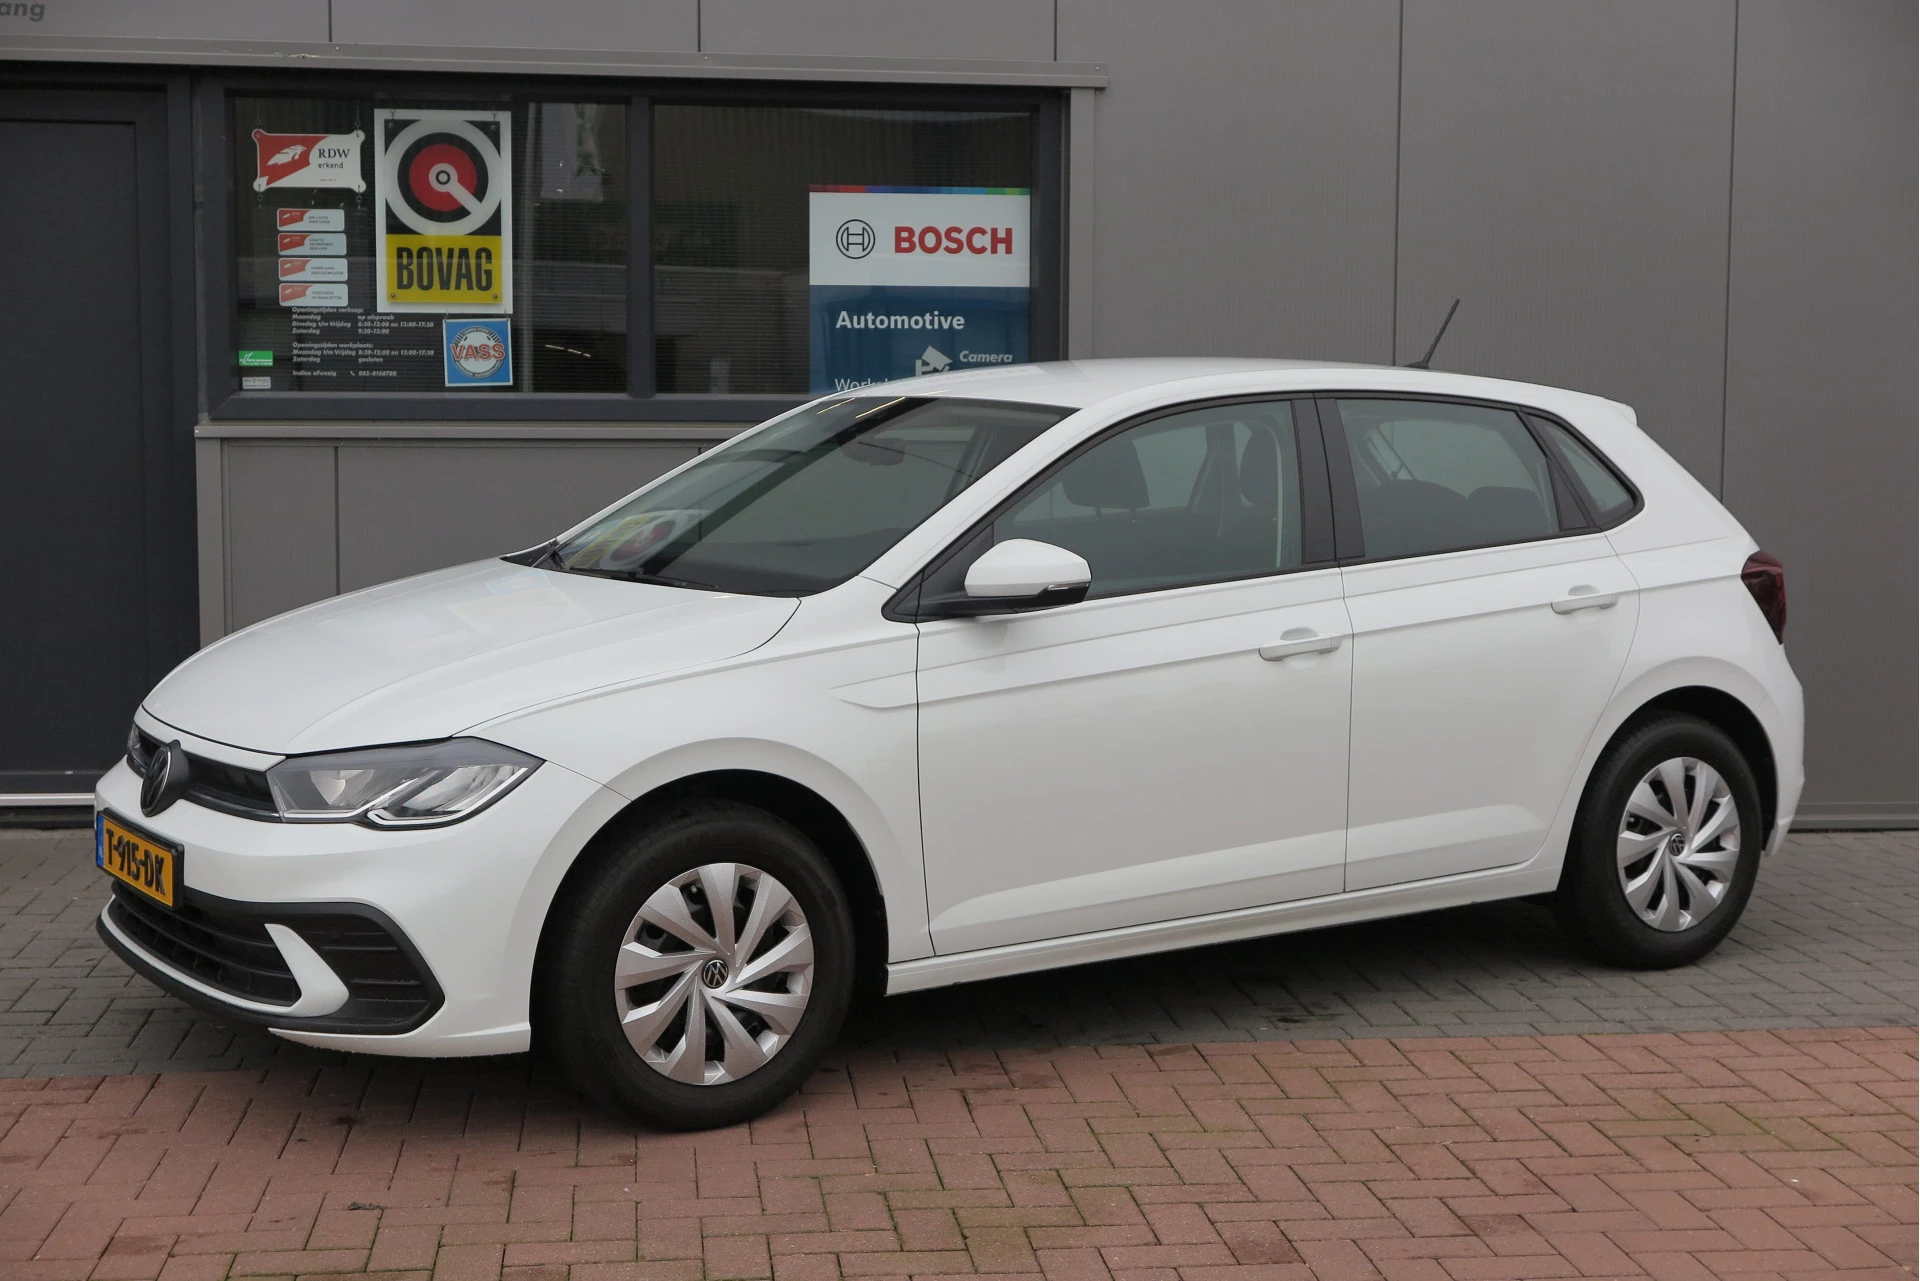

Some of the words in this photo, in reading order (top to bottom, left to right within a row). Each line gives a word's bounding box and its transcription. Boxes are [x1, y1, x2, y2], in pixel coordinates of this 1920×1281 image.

[318, 148, 350, 159] RDW
[894, 226, 1013, 255] BOSCH
[396, 246, 493, 292] BOVAG
[835, 310, 965, 330] Automotive
[450, 343, 505, 361] VASS
[959, 350, 1013, 363] Camera
[106, 827, 166, 896] T-915-DK
